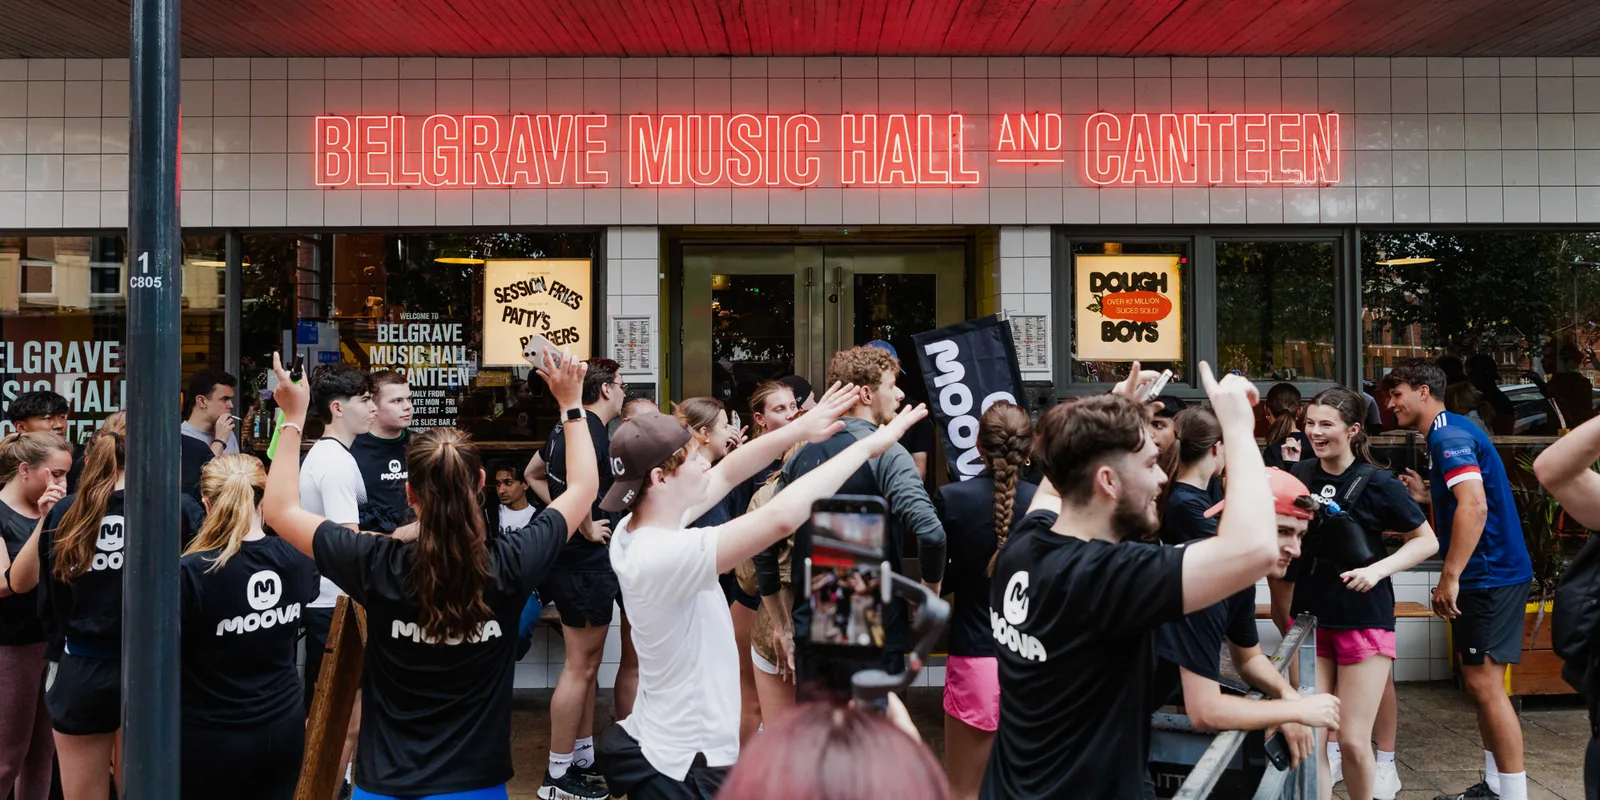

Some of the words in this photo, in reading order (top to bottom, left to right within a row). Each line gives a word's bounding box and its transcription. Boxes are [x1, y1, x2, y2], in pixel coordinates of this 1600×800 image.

[315, 114, 608, 186] BELGRAVE
[629, 114, 820, 186] MUSIC
[841, 114, 979, 184] HALL
[998, 113, 1062, 151] AND
[1085, 112, 1340, 185] CANTEEN
[138, 252, 149, 273] 1
[130, 276, 162, 288] C805
[494, 276, 547, 304] SESSION
[548, 280, 583, 310] FRIES
[1089, 271, 1167, 293] DOUGH
[400, 312, 430, 320] WELCOME
[431, 312, 439, 320] TO
[502, 305, 551, 331] PATTY'S
[377, 323, 463, 342] BELGRAVE
[520, 326, 580, 350] BGERS
[1101, 320, 1159, 343] BOYS
[0, 340, 120, 374] LGRAVE
[369, 345, 425, 365] MUSIC
[430, 345, 470, 365] HALL
[428, 390, 445, 398] FROM
[924, 339, 987, 481] MOOV
[216, 602, 301, 636] MOOVA
